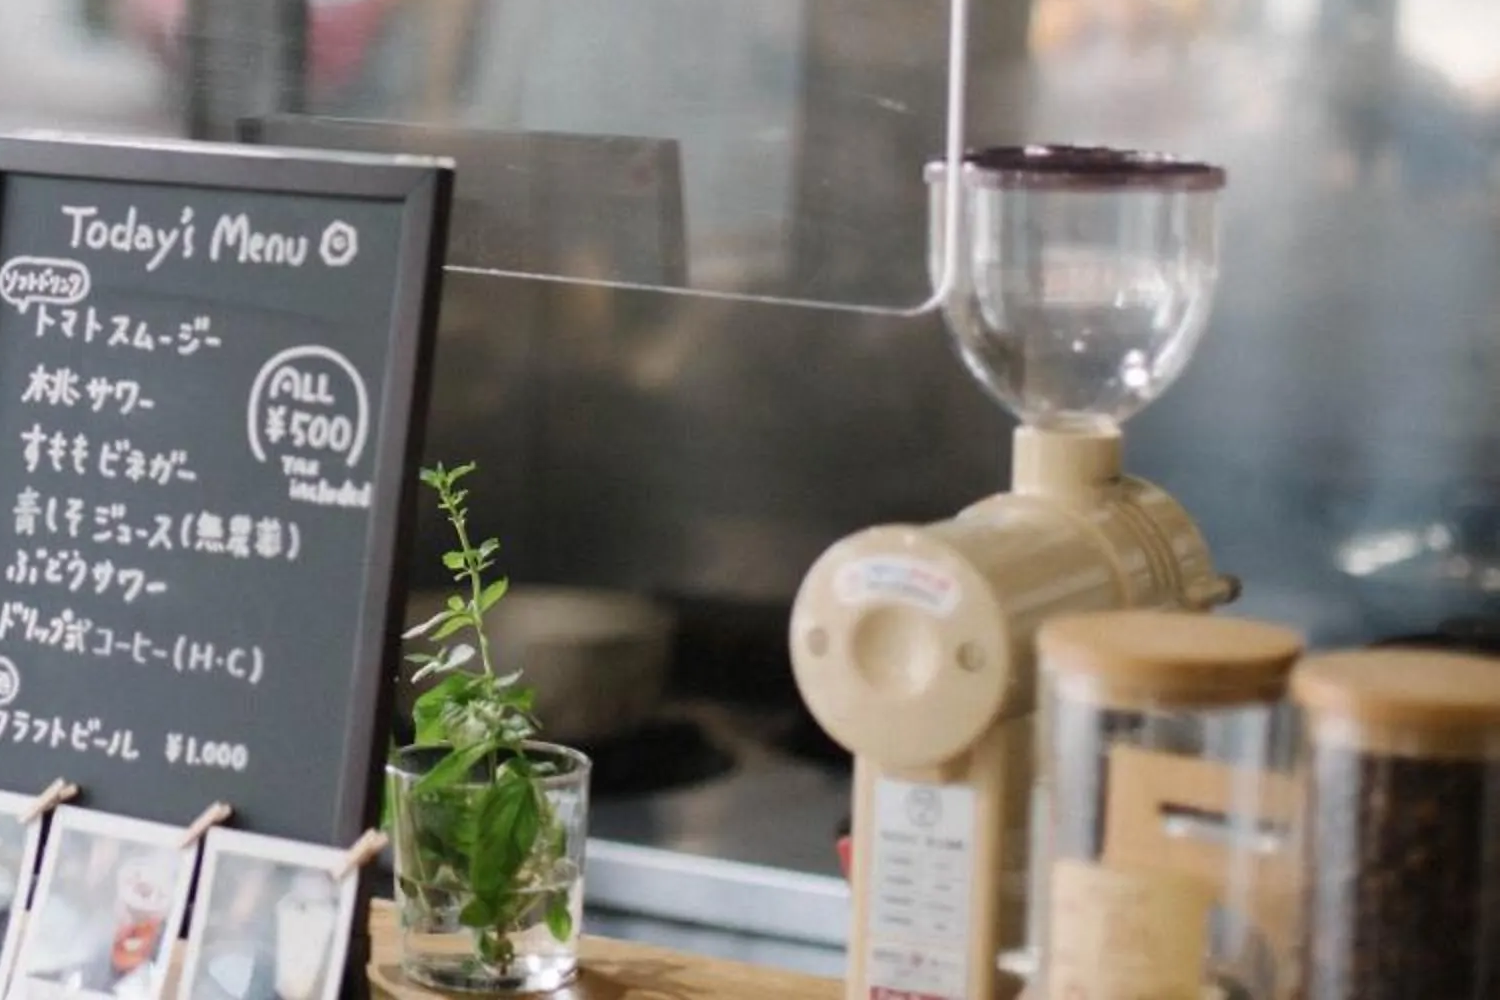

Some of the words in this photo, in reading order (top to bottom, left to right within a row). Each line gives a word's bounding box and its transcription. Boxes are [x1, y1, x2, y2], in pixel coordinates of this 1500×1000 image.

[62, 205, 195, 270] Today's
[210, 214, 308, 266] Menu
[35, 305, 222, 355] トマトスムージー
[21, 364, 155, 413] 桃サワー
[270, 365, 335, 403] ALL
[19, 424, 197, 484] すももビネガー
[264, 408, 353, 451] ¥500
[5, 548, 168, 602] ぶどうサワー
